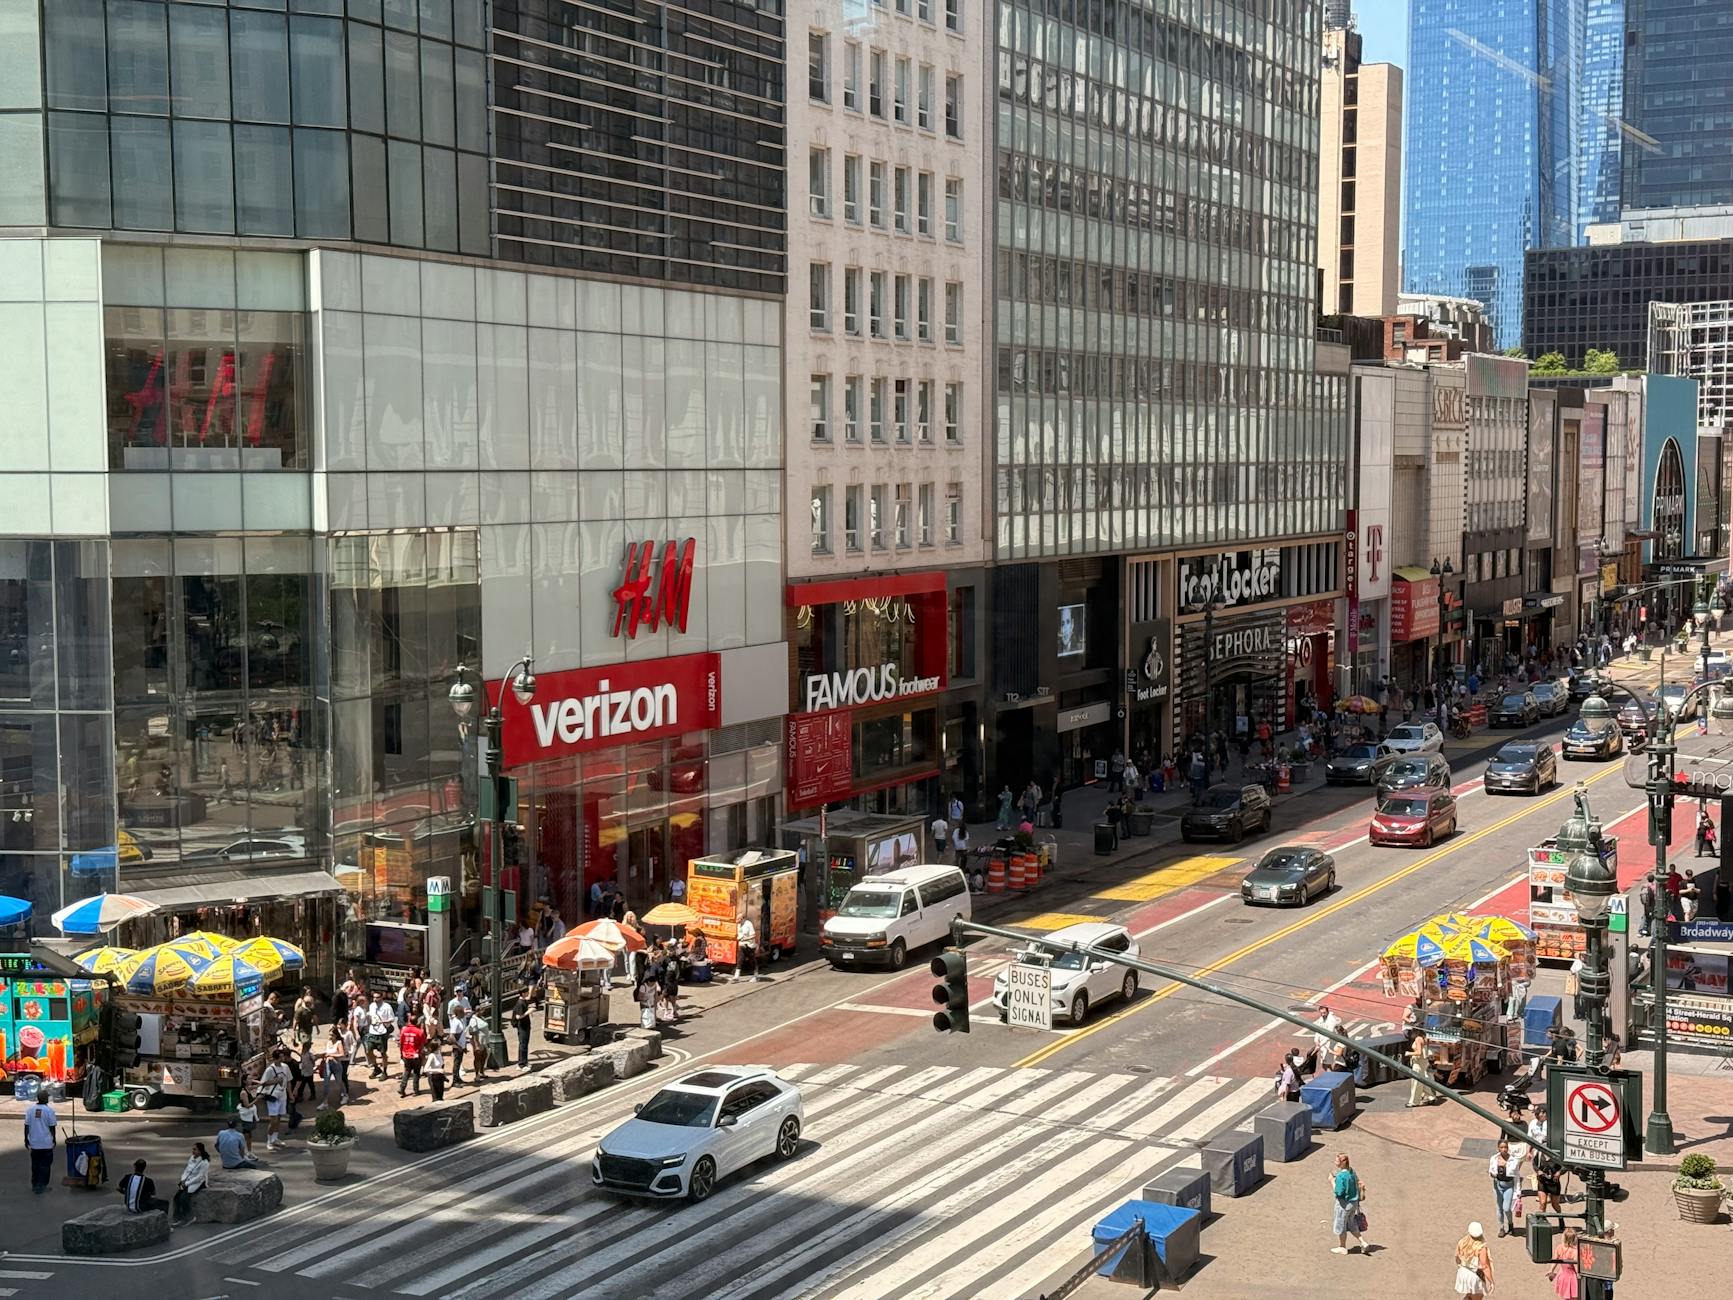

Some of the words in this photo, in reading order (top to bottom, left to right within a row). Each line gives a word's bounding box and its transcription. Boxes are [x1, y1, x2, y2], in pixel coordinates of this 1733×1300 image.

[1347, 541, 1355, 592] target
[608, 537, 696, 640] H&M
[1180, 563, 1219, 608] Foot
[1222, 559, 1279, 605] Locker
[707, 671, 716, 711] verizon
[806, 662, 897, 713] FAMOUS
[899, 675, 940, 696] footwear
[1137, 687, 1149, 701] Foot
[1150, 684, 1168, 698] Locker
[531, 679, 678, 748] verizon
[788, 720, 797, 758] FAMOUS
[1681, 926, 1733, 940] Broadway
[197, 984, 232, 993] SABRETT
[1011, 970, 1048, 989] BUSES
[1014, 988, 1045, 1006] ONLY
[1012, 1006, 1047, 1026] SIGNAL
[437, 1116, 452, 1138] 7
[1578, 1138, 1608, 1149] EXCEPT
[1571, 1148, 1586, 1158] MTA
[1590, 1150, 1617, 1162] BUSES
